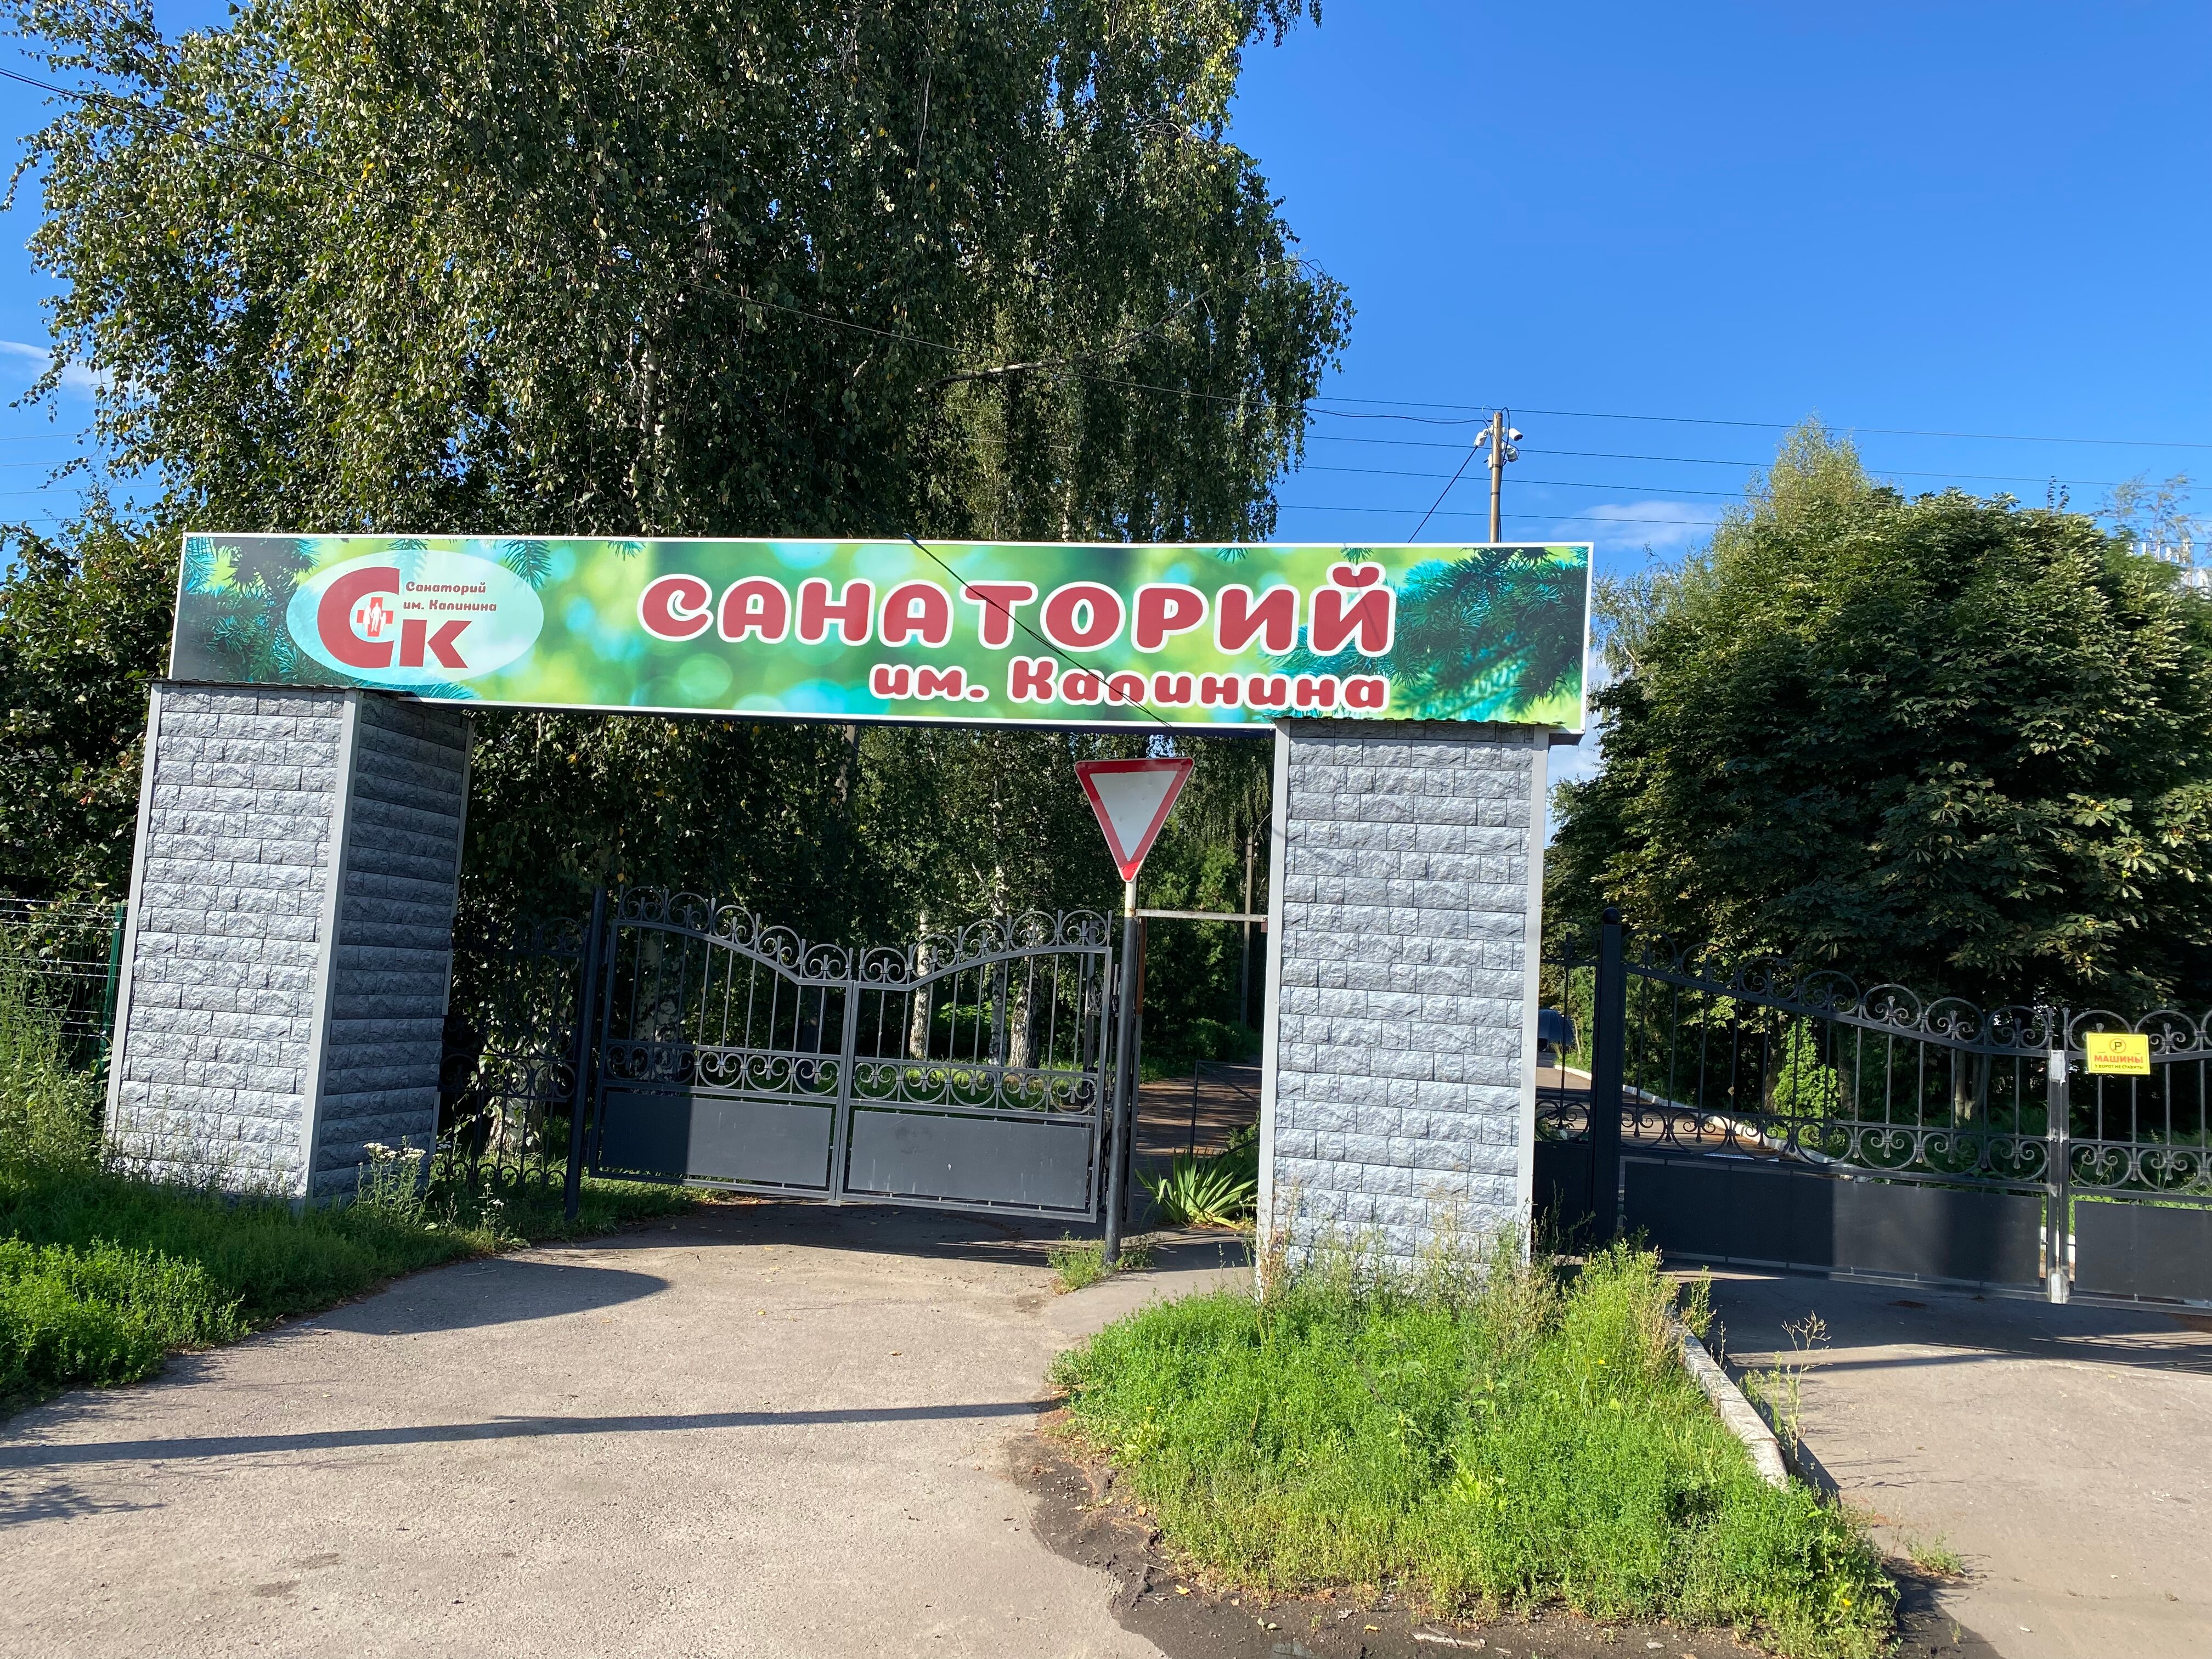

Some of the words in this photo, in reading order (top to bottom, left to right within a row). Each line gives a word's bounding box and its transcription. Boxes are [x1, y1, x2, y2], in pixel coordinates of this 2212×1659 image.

[405, 581, 486, 596] Санаторий
[403, 601, 425, 610] им.
[429, 599, 497, 612] Калинина
[641, 566, 1390, 652] САНАТОРИЙ
[873, 667, 984, 698] им.
[1012, 660, 1385, 708] Калинина
[2094, 1055, 2143, 1063] МАШИНЫ
